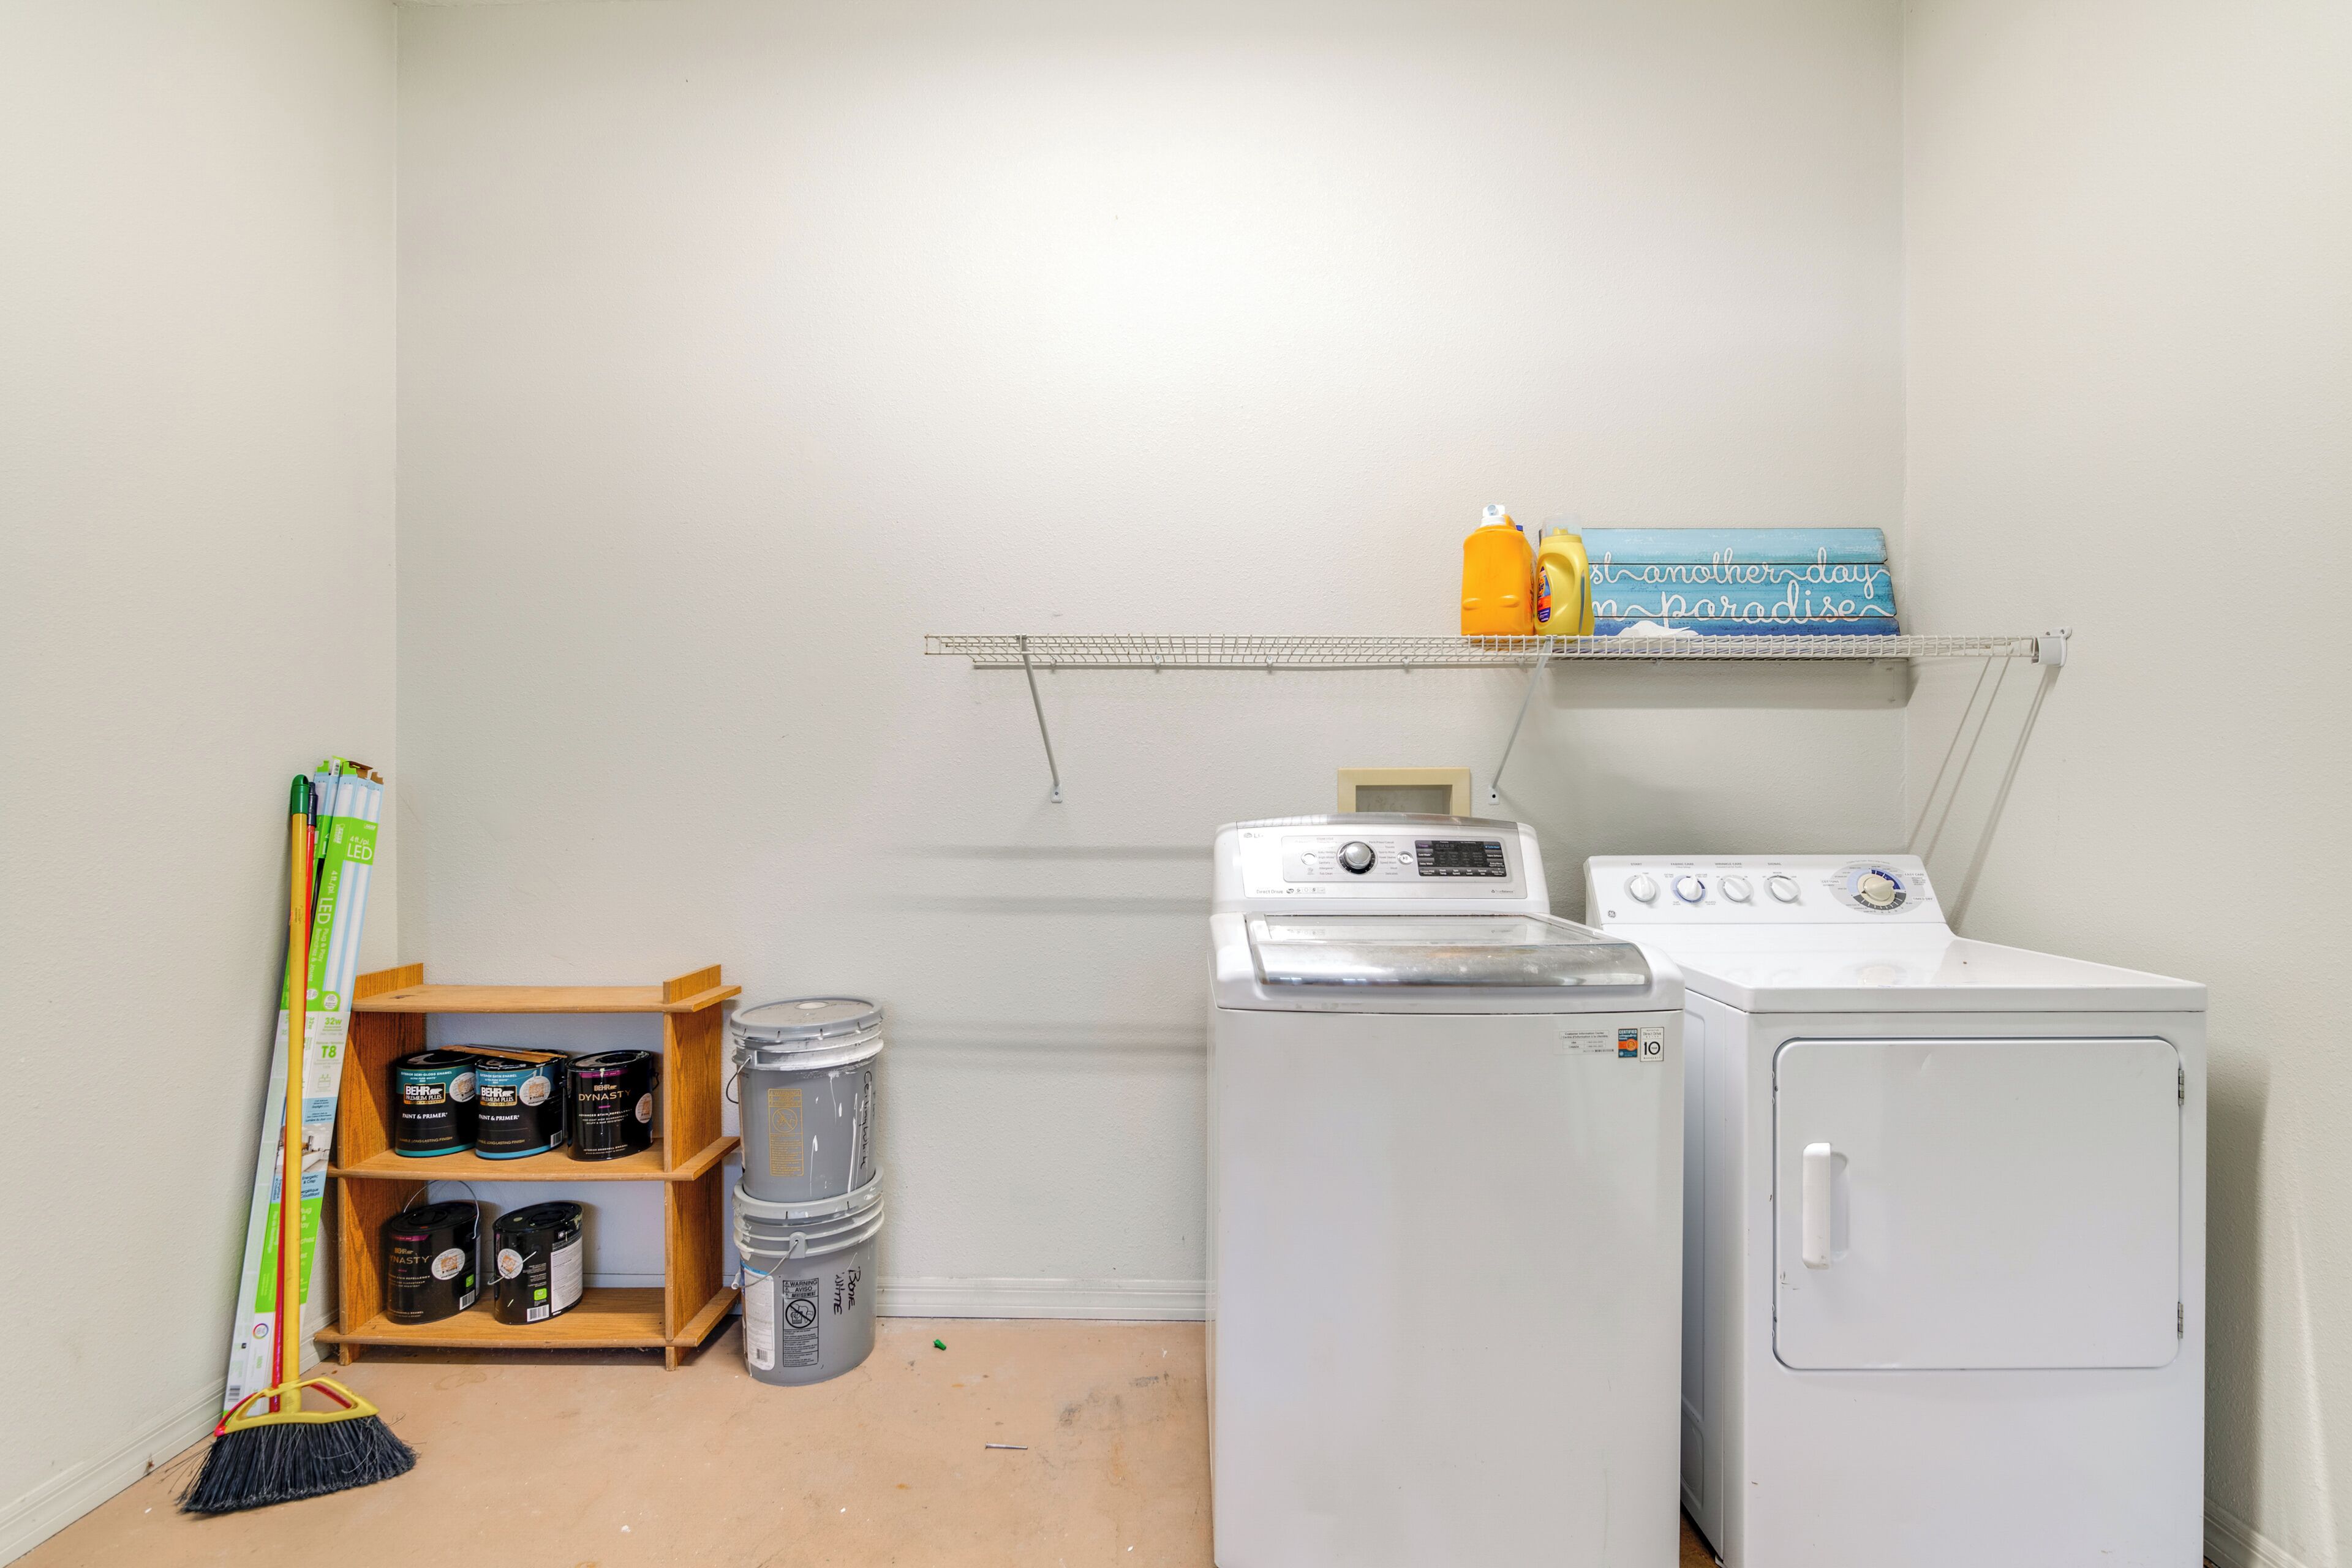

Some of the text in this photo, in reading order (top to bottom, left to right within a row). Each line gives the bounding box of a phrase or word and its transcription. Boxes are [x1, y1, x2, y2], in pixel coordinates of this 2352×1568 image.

[1806, 546, 1879, 600] day
[1660, 579, 1860, 628] paradise
[347, 843, 372, 860] LED
[317, 897, 334, 924] LED
[321, 1045, 337, 1058] T8
[1644, 1041, 1660, 1055] 10
[405, 1085, 431, 1096] BEHR
[481, 1087, 503, 1097] BEHR
[578, 1090, 631, 1101] DYNASTY
[390, 1254, 429, 1264] YNASTY
